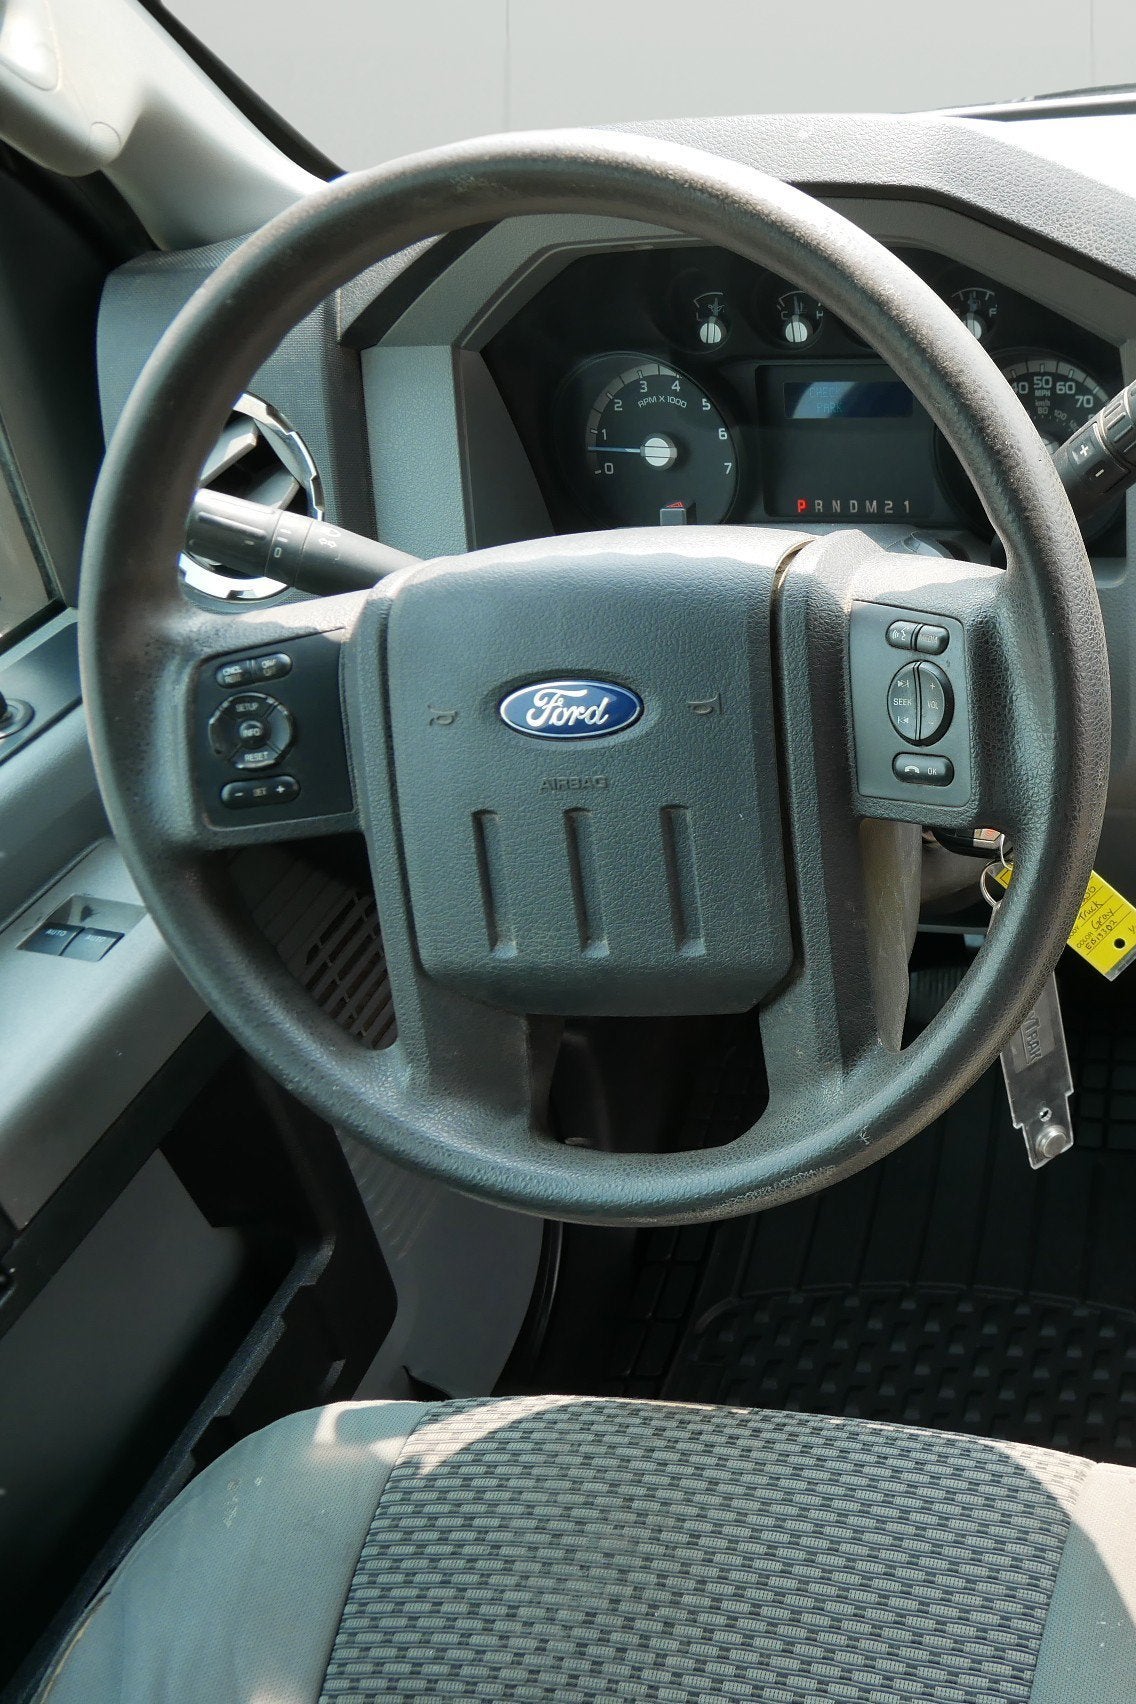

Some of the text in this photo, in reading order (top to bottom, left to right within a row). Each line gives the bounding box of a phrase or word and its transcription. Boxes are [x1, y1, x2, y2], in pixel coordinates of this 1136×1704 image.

[639, 380, 648, 393] 3
[671, 380, 681, 392] 4
[1033, 376, 1052, 389] 50
[1055, 382, 1076, 395] 60
[1034, 389, 1051, 397] MPH
[614, 400, 623, 411] 2
[638, 396, 657, 408] RPM
[667, 396, 688, 408] 1000
[702, 399, 711, 411] 5
[1075, 395, 1094, 408] 70
[1053, 409, 1068, 421] 100
[601, 428, 607, 441] 1
[718, 428, 728, 440] 6
[604, 462, 614, 475] 0
[723, 462, 732, 475] 7
[797, 499, 910, 513] P R N D M 2 1
[235, 702, 259, 713] SETUP
[525, 688, 611, 727] Ford
[893, 698, 912, 706] SEEK
[927, 701, 939, 710] VOL
[242, 728, 262, 737] INFO
[244, 751, 269, 762] RESET
[927, 767, 938, 776] OK
[538, 775, 609, 793] AIRBAG
[1079, 899, 1104, 921] Truck
[46, 928, 68, 937] AUTO
[1076, 931, 1094, 949] COLOR
